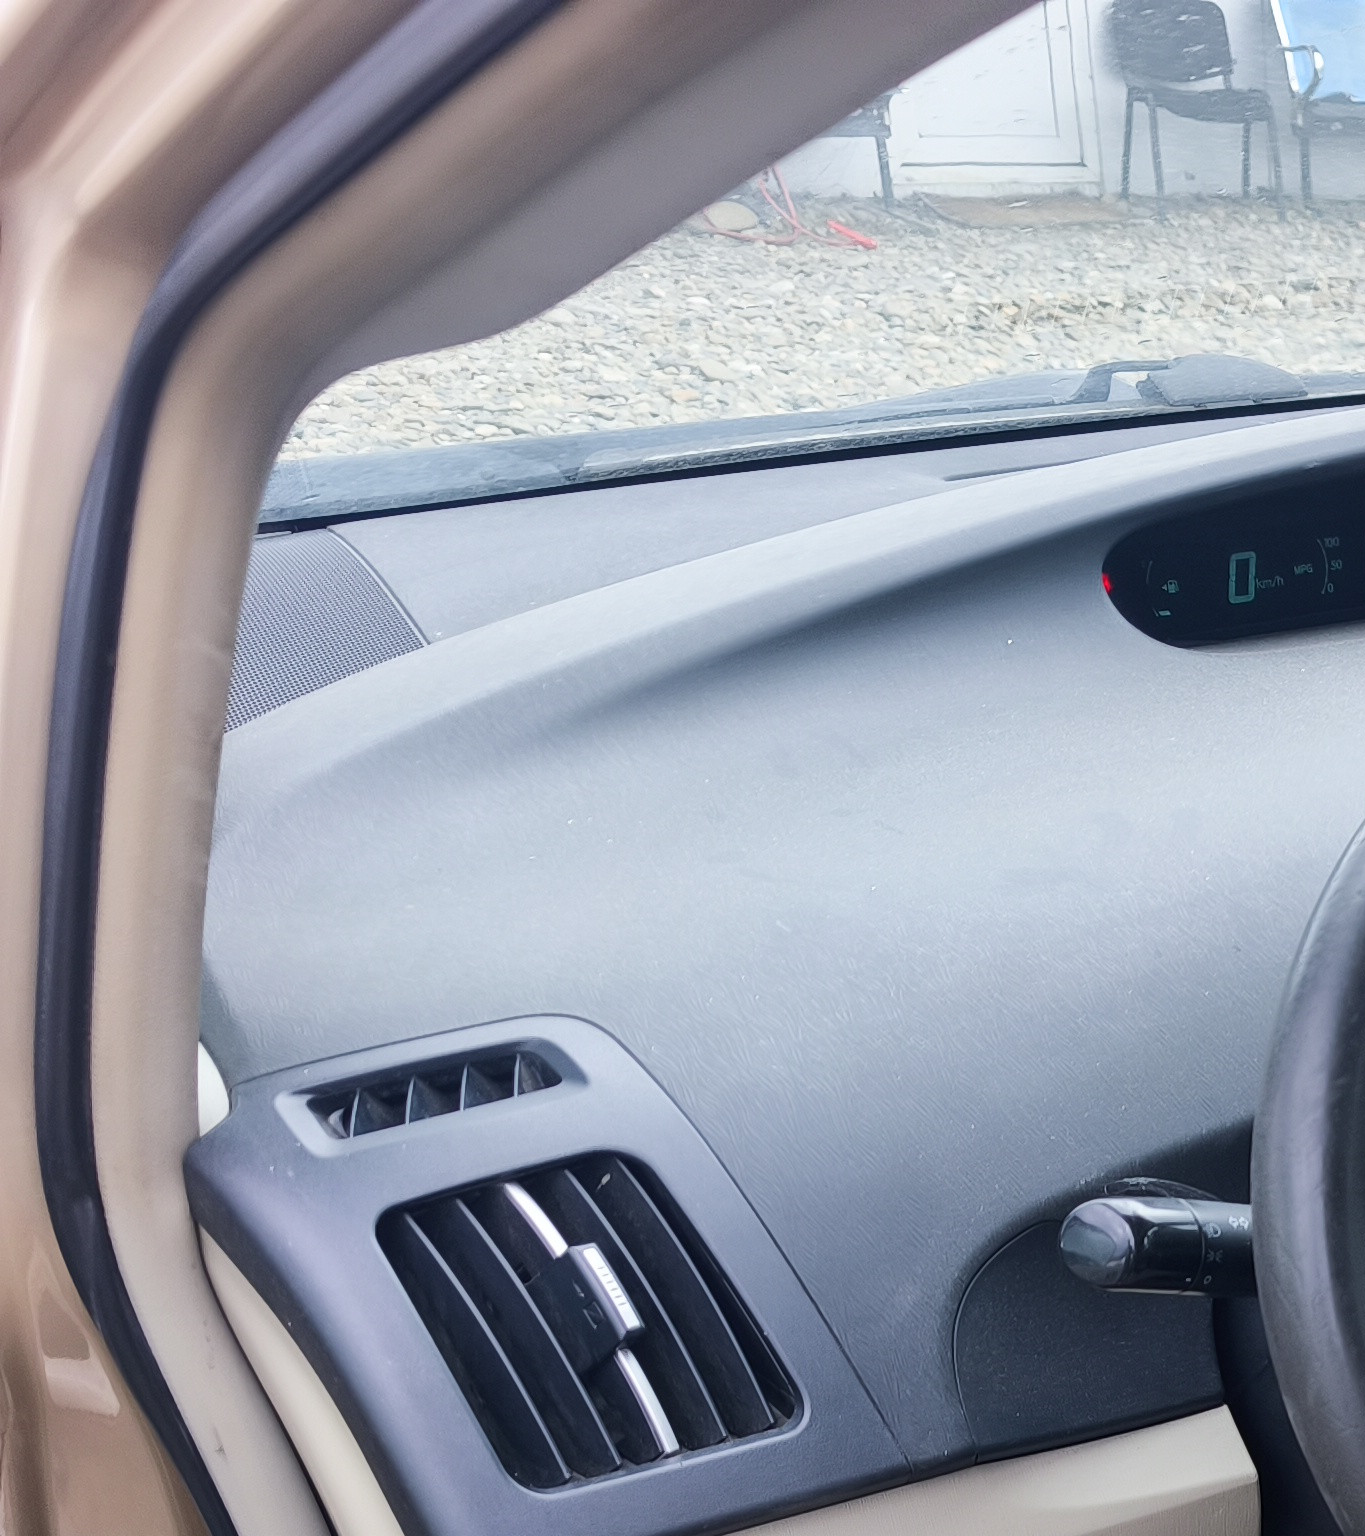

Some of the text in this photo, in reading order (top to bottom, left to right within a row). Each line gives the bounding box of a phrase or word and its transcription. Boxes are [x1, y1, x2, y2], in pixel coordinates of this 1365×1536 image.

[1293, 564, 1313, 575] MPG
[1331, 559, 1343, 570] 50
[1229, 551, 1284, 604] 0 km/h
